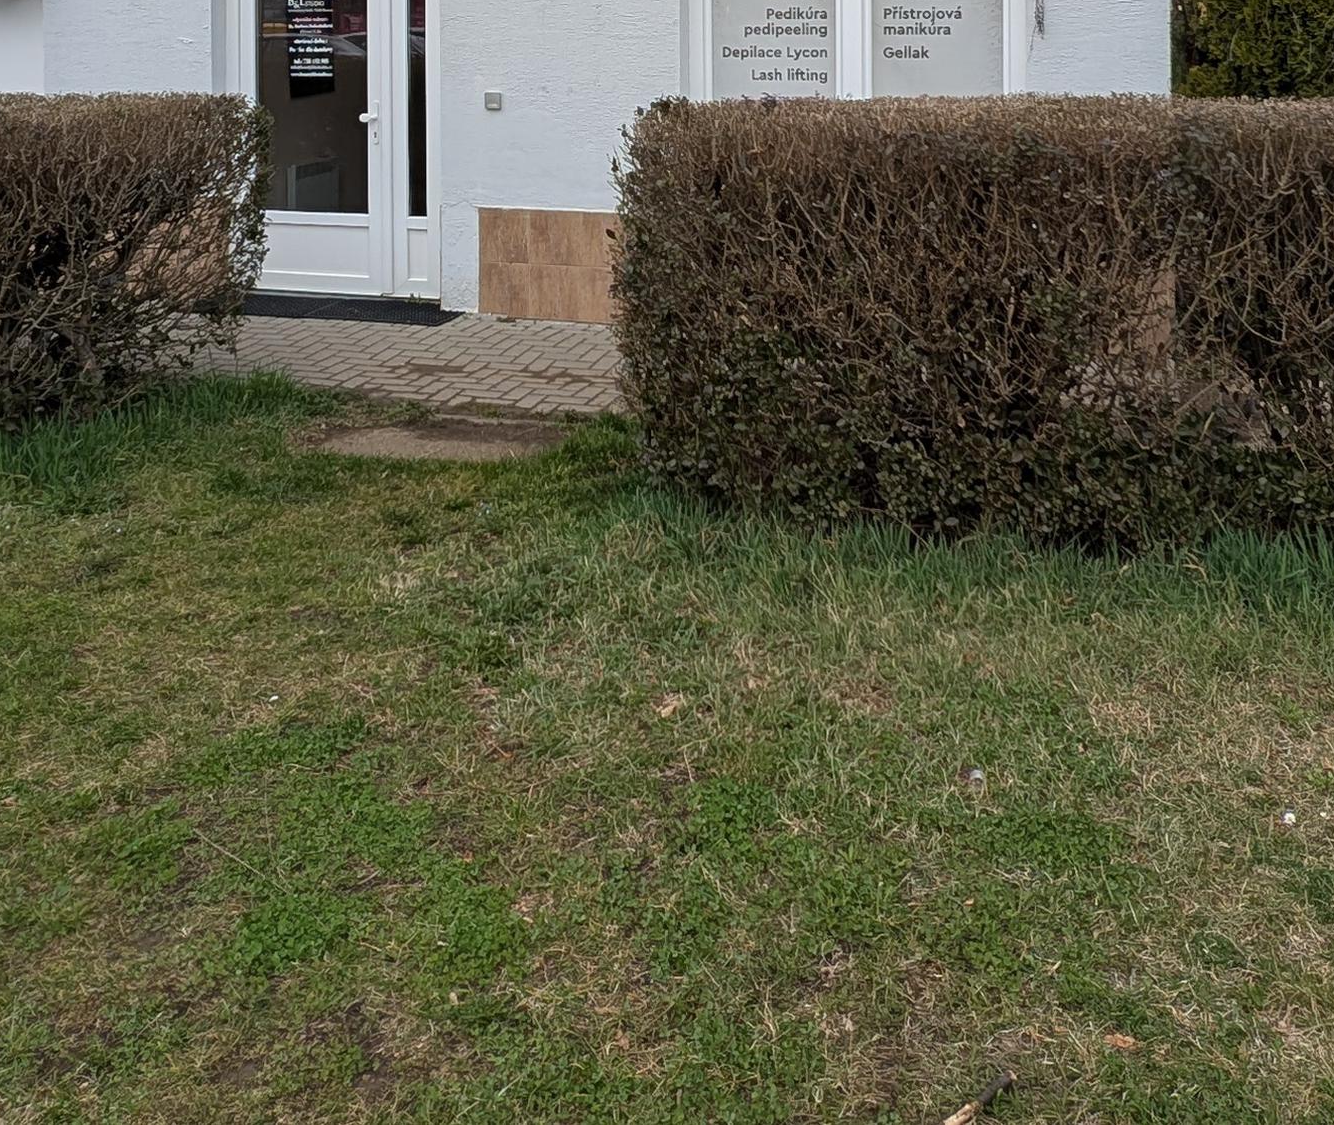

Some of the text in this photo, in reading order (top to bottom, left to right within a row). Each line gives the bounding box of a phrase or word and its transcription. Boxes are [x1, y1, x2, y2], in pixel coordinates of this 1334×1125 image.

[766, 6, 828, 20] Pedikúra
[883, 6, 963, 24] Přístrojová
[743, 22, 828, 38] pedipeeling
[883, 21, 952, 36] manikúra
[722, 45, 828, 61] Depilace Lycon
[882, 45, 930, 59] Gellak
[751, 68, 828, 84] Lash lifting
